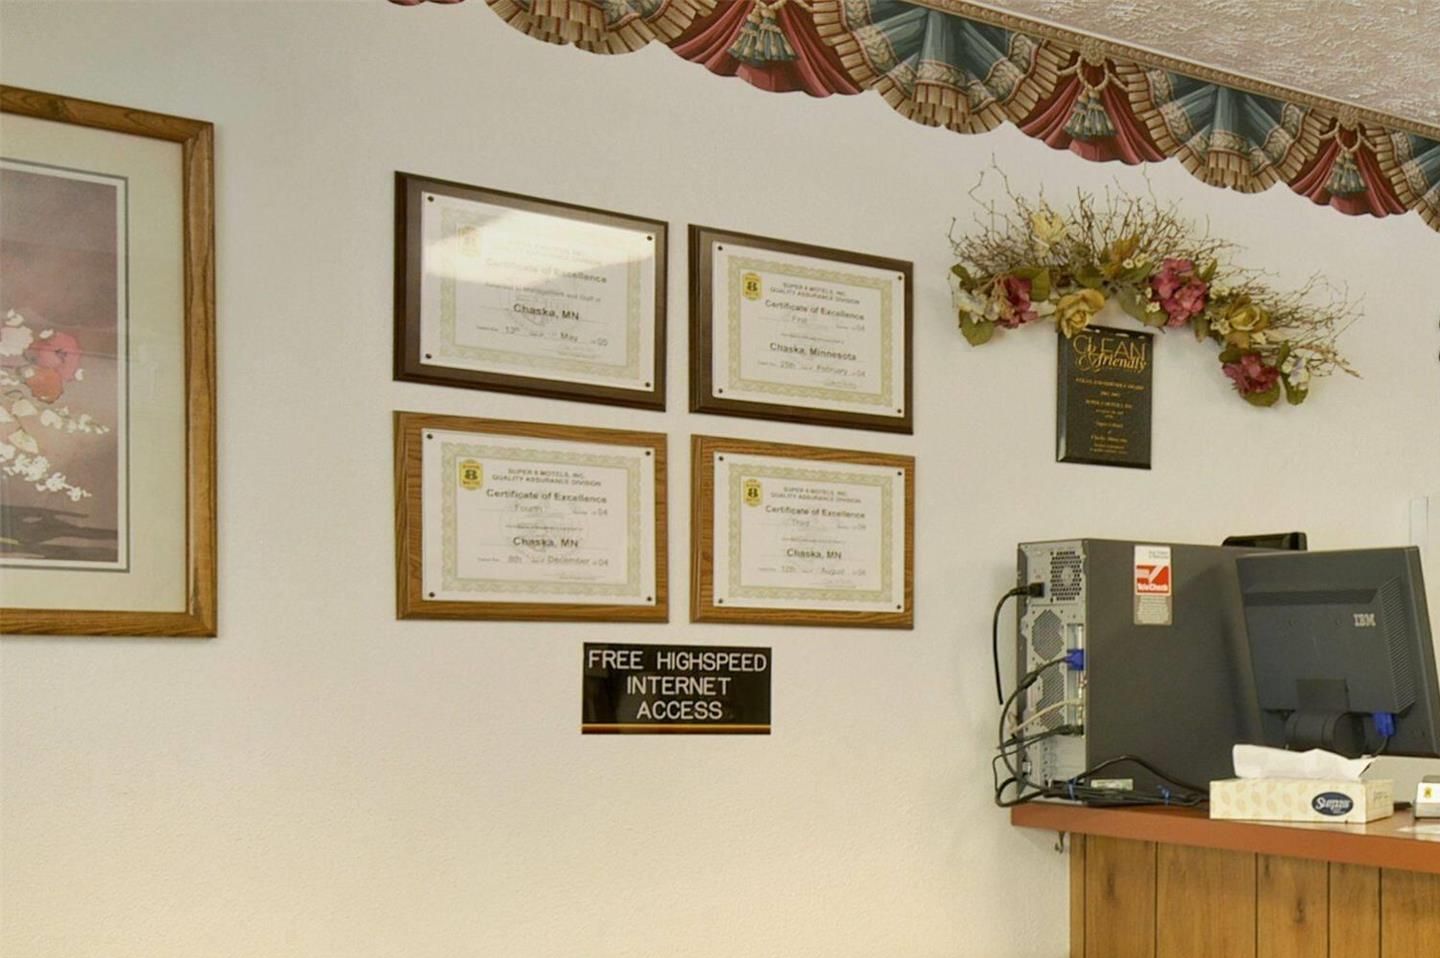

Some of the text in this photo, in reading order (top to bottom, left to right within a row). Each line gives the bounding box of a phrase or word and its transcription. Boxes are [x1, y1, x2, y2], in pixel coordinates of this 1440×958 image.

[561, 309, 579, 321] MN
[765, 299, 865, 322] Certificate of Excellence
[809, 346, 857, 361] Minnesota
[486, 488, 608, 504] Certificate of Excellence
[765, 504, 866, 520] Certificate of Excellence
[560, 537, 579, 549] MN
[826, 549, 842, 560] MN
[1353, 613, 1376, 627] IBM
[588, 650, 767, 673] FREE HIGHSPEED
[626, 675, 731, 696] INTERNET
[636, 700, 724, 720] ACCESS
